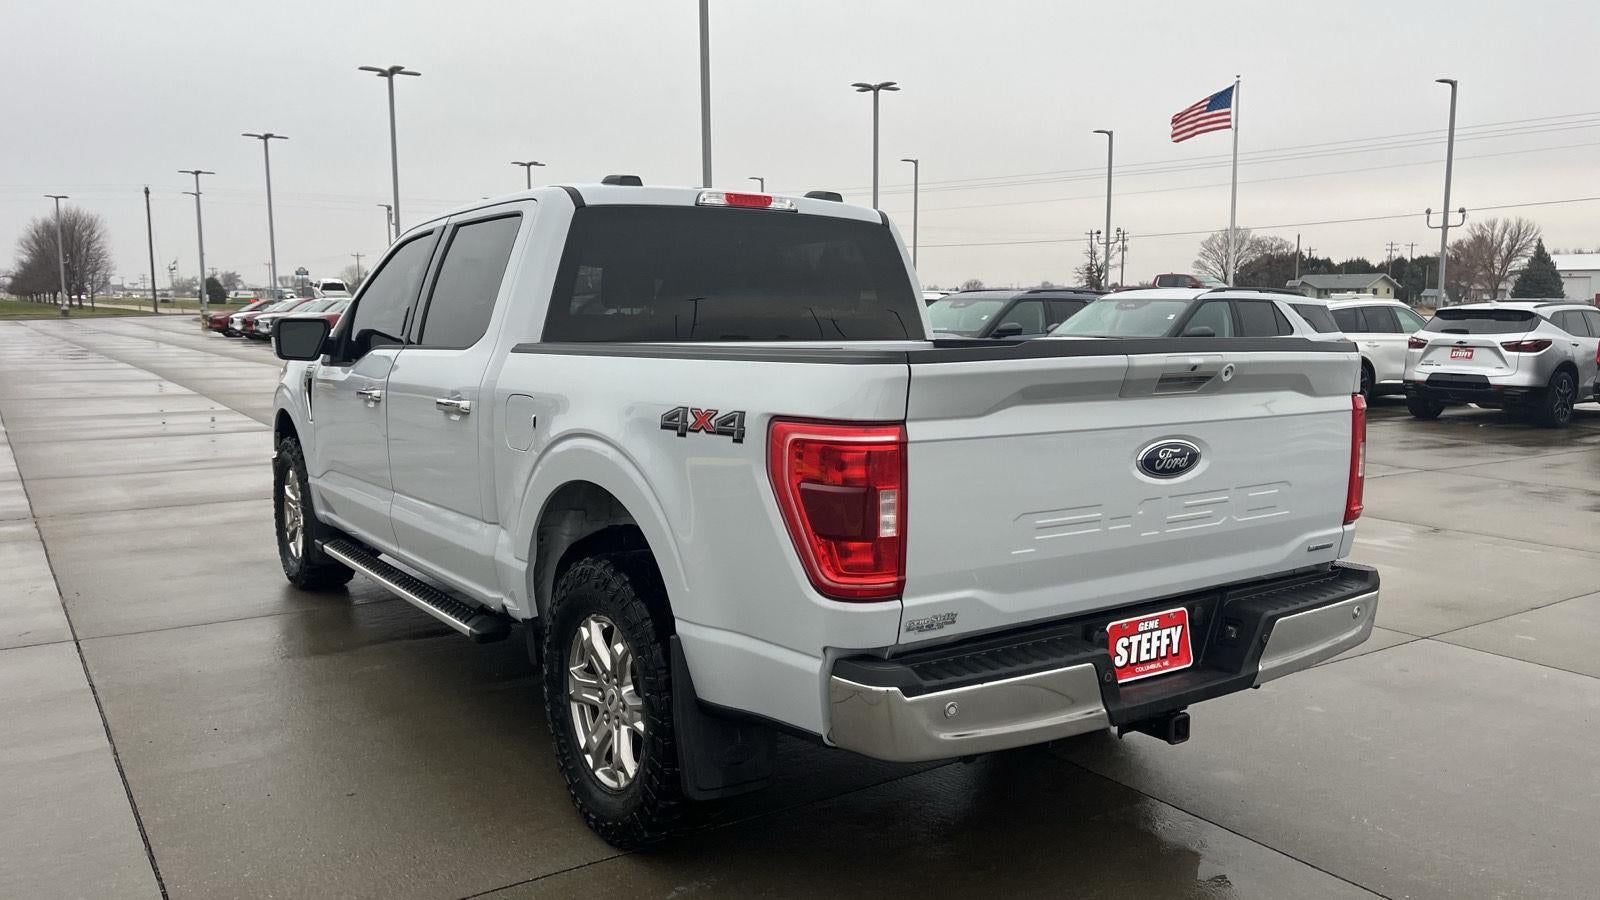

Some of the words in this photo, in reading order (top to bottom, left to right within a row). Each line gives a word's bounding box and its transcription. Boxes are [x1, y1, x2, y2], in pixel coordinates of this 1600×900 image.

[1155, 447, 1189, 470] Ford
[1011, 480, 1293, 554] F-150
[1138, 619, 1160, 632] GENE
[1114, 625, 1183, 668] STEFFY
